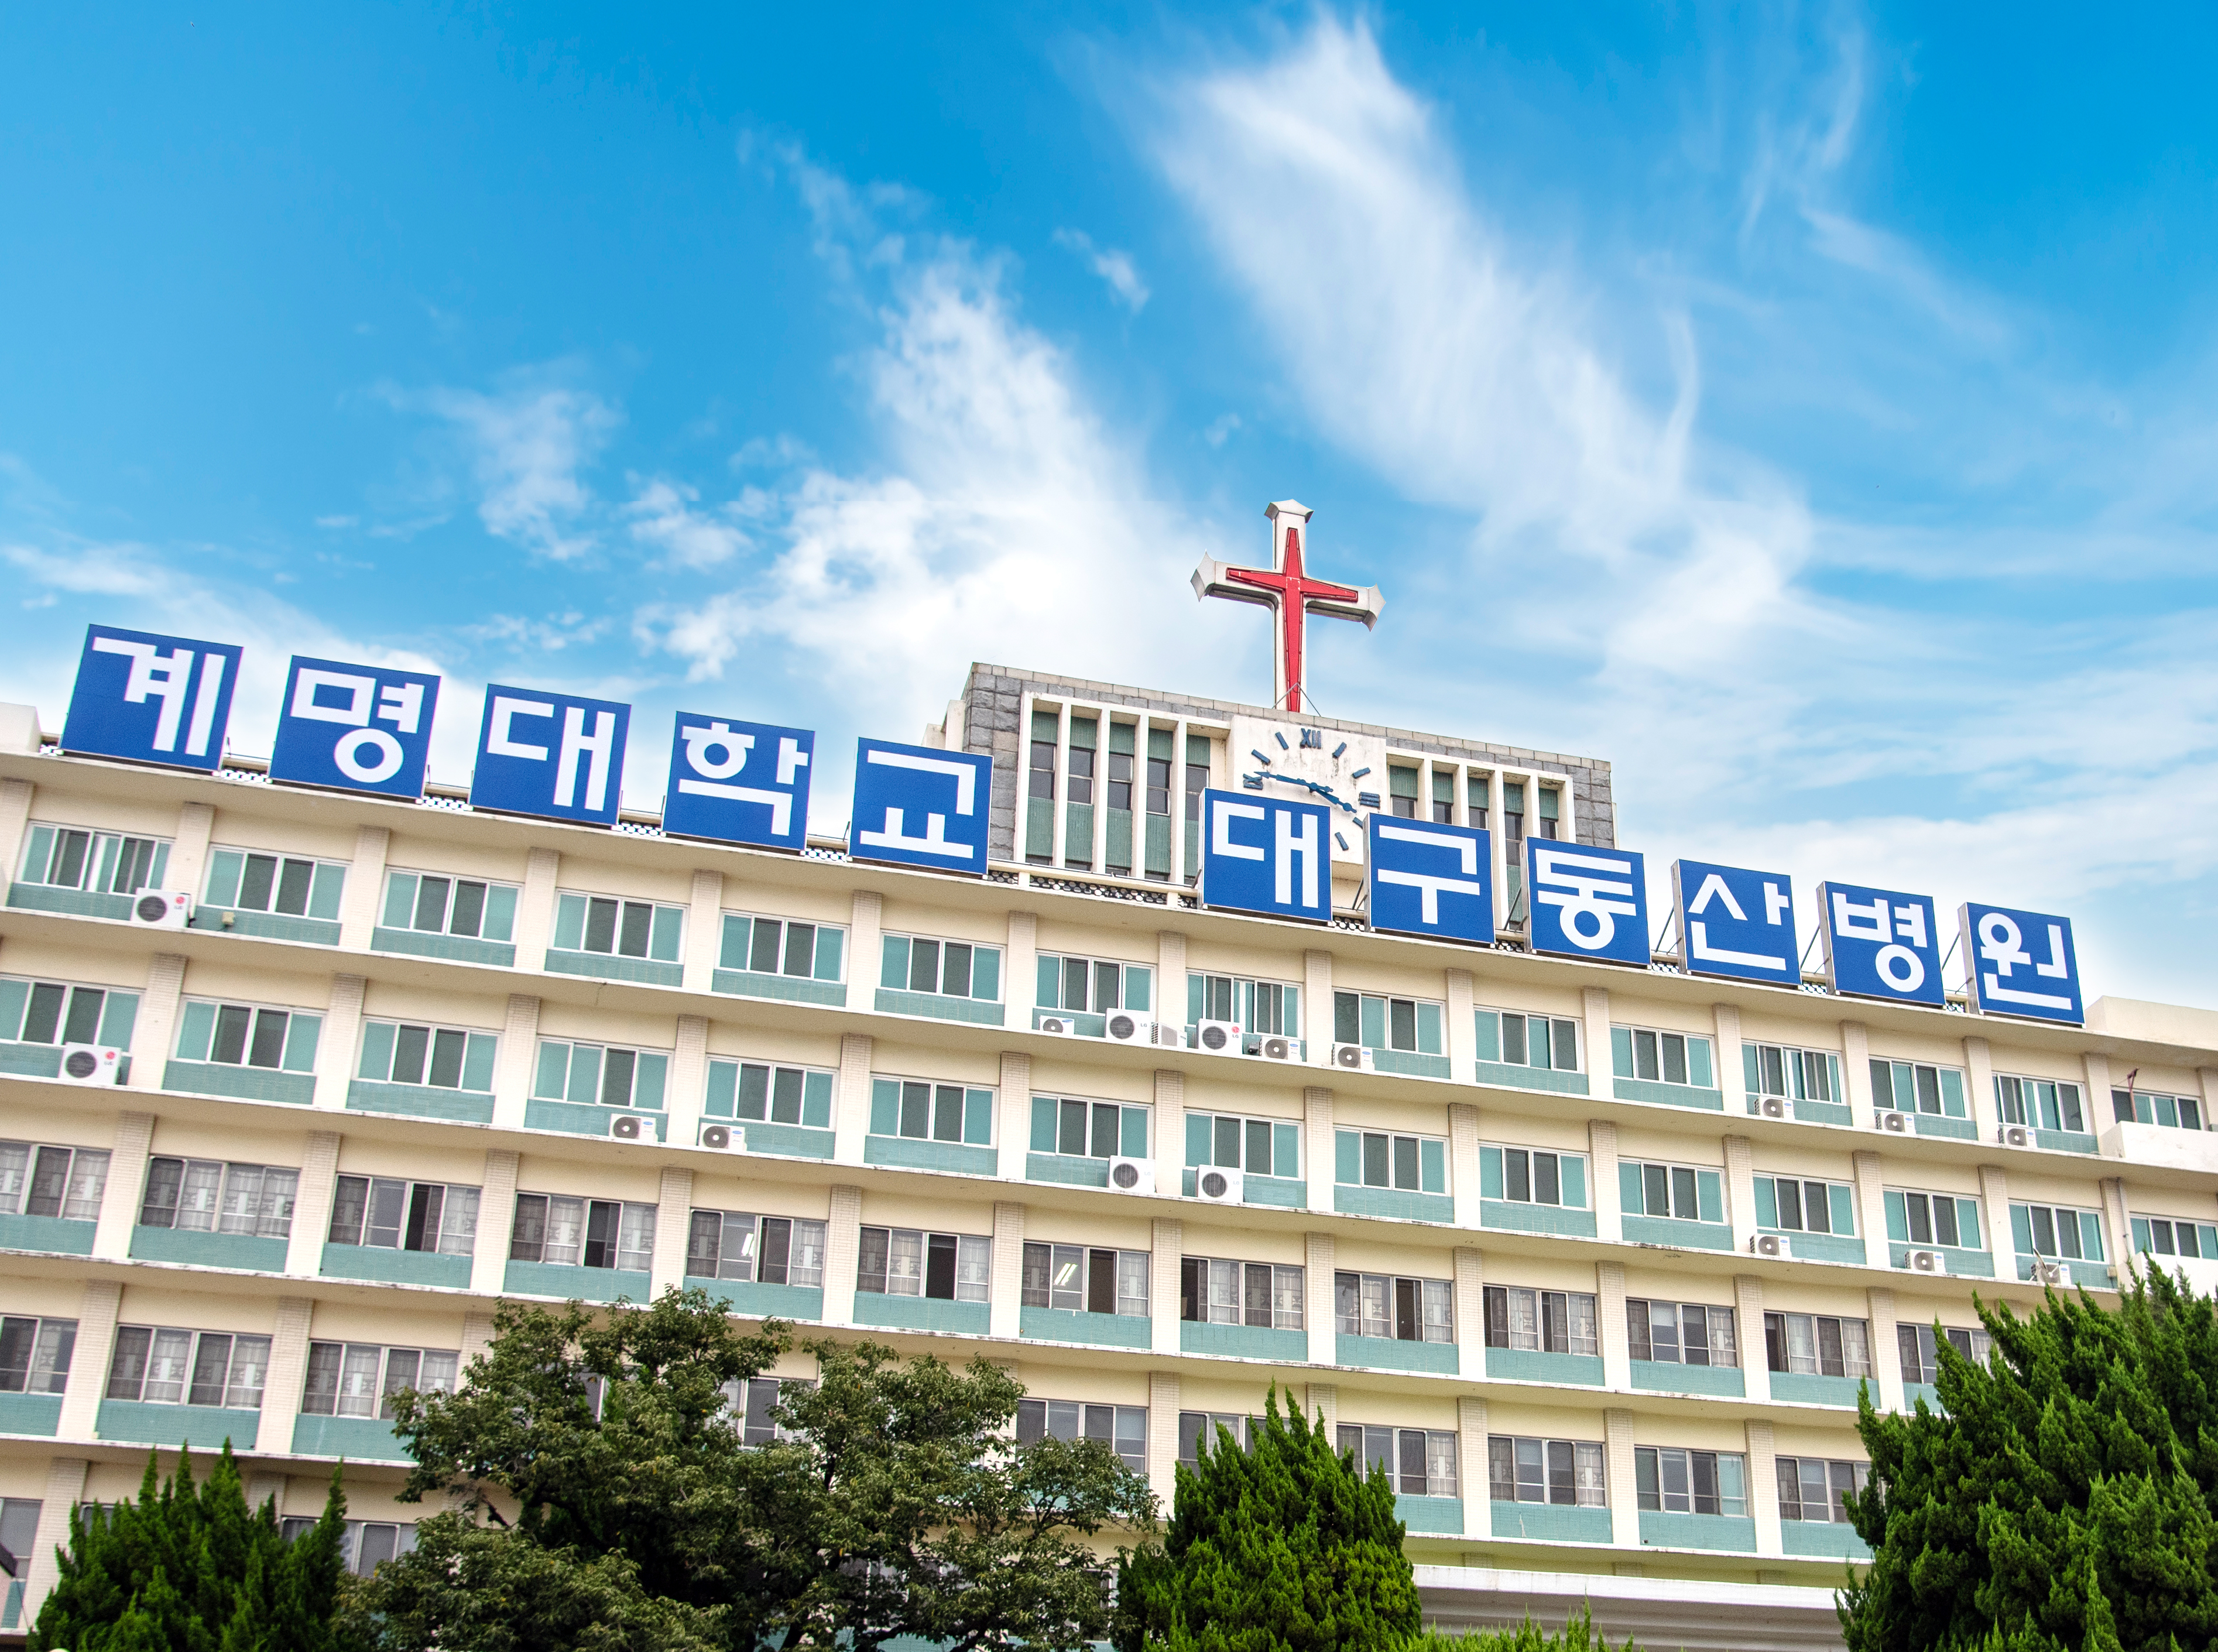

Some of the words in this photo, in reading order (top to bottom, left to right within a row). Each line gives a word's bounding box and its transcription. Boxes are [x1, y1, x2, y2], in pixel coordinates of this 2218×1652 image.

[1300, 728, 1321, 749] XII
[1359, 791, 1380, 807] III
[93, 637, 976, 859] 계명대학교
[1212, 800, 2072, 1010] 대구동산병원
